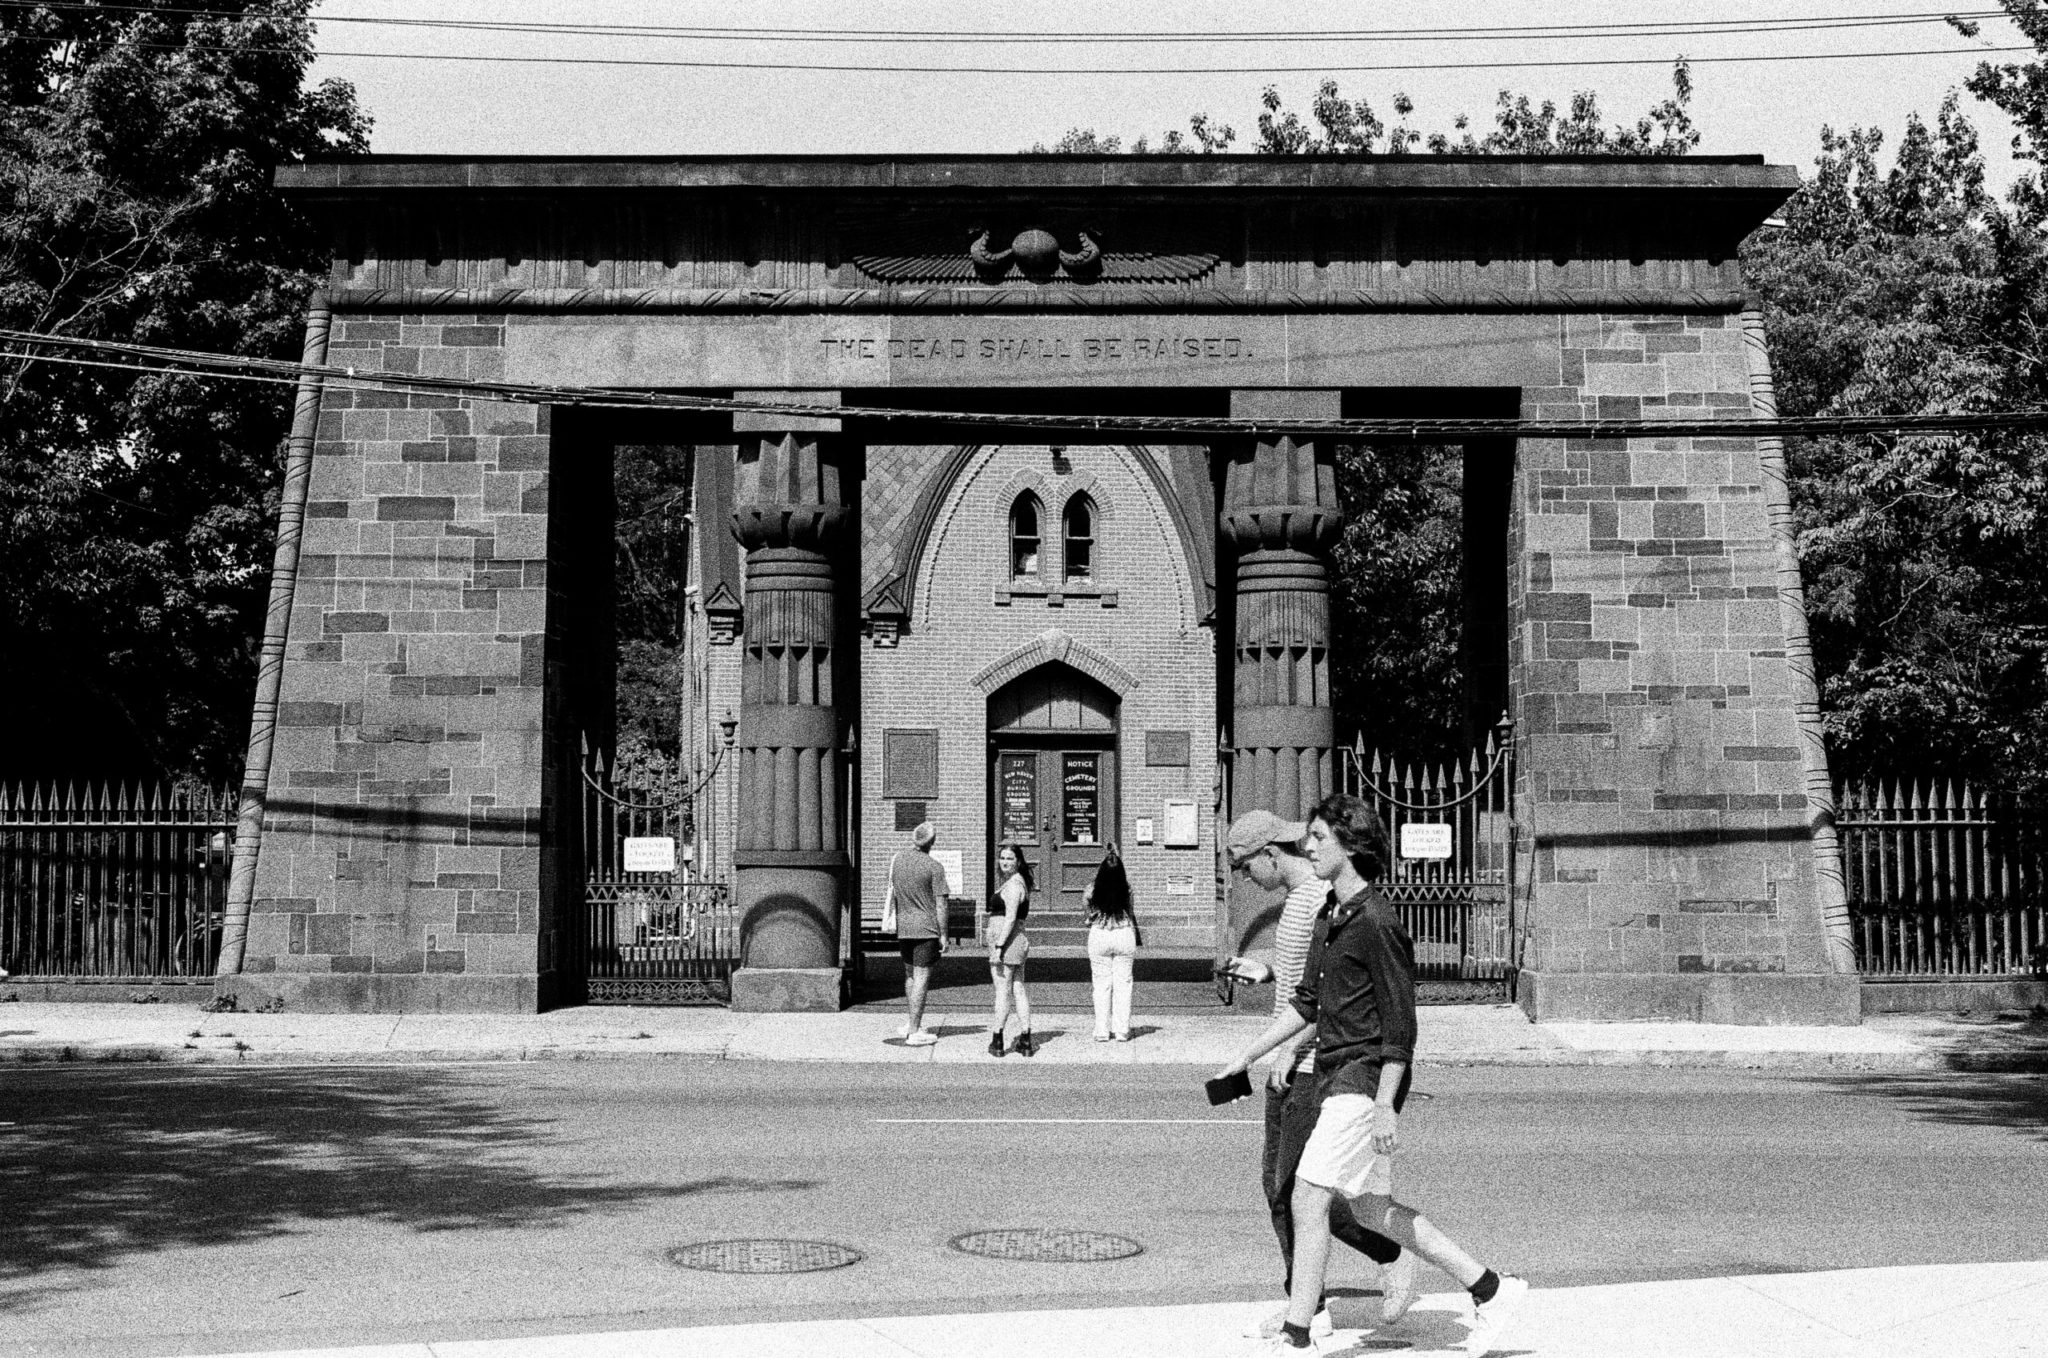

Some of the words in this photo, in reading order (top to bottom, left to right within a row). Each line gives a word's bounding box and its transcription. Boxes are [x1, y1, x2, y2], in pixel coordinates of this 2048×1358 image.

[820, 339, 875, 359] THE
[888, 339, 967, 359] DEAD
[979, 338, 1071, 359] SHALL
[1083, 338, 1122, 358] BE
[1134, 338, 1253, 358] RAISED.
[1065, 774, 1097, 783] CEMETERY
